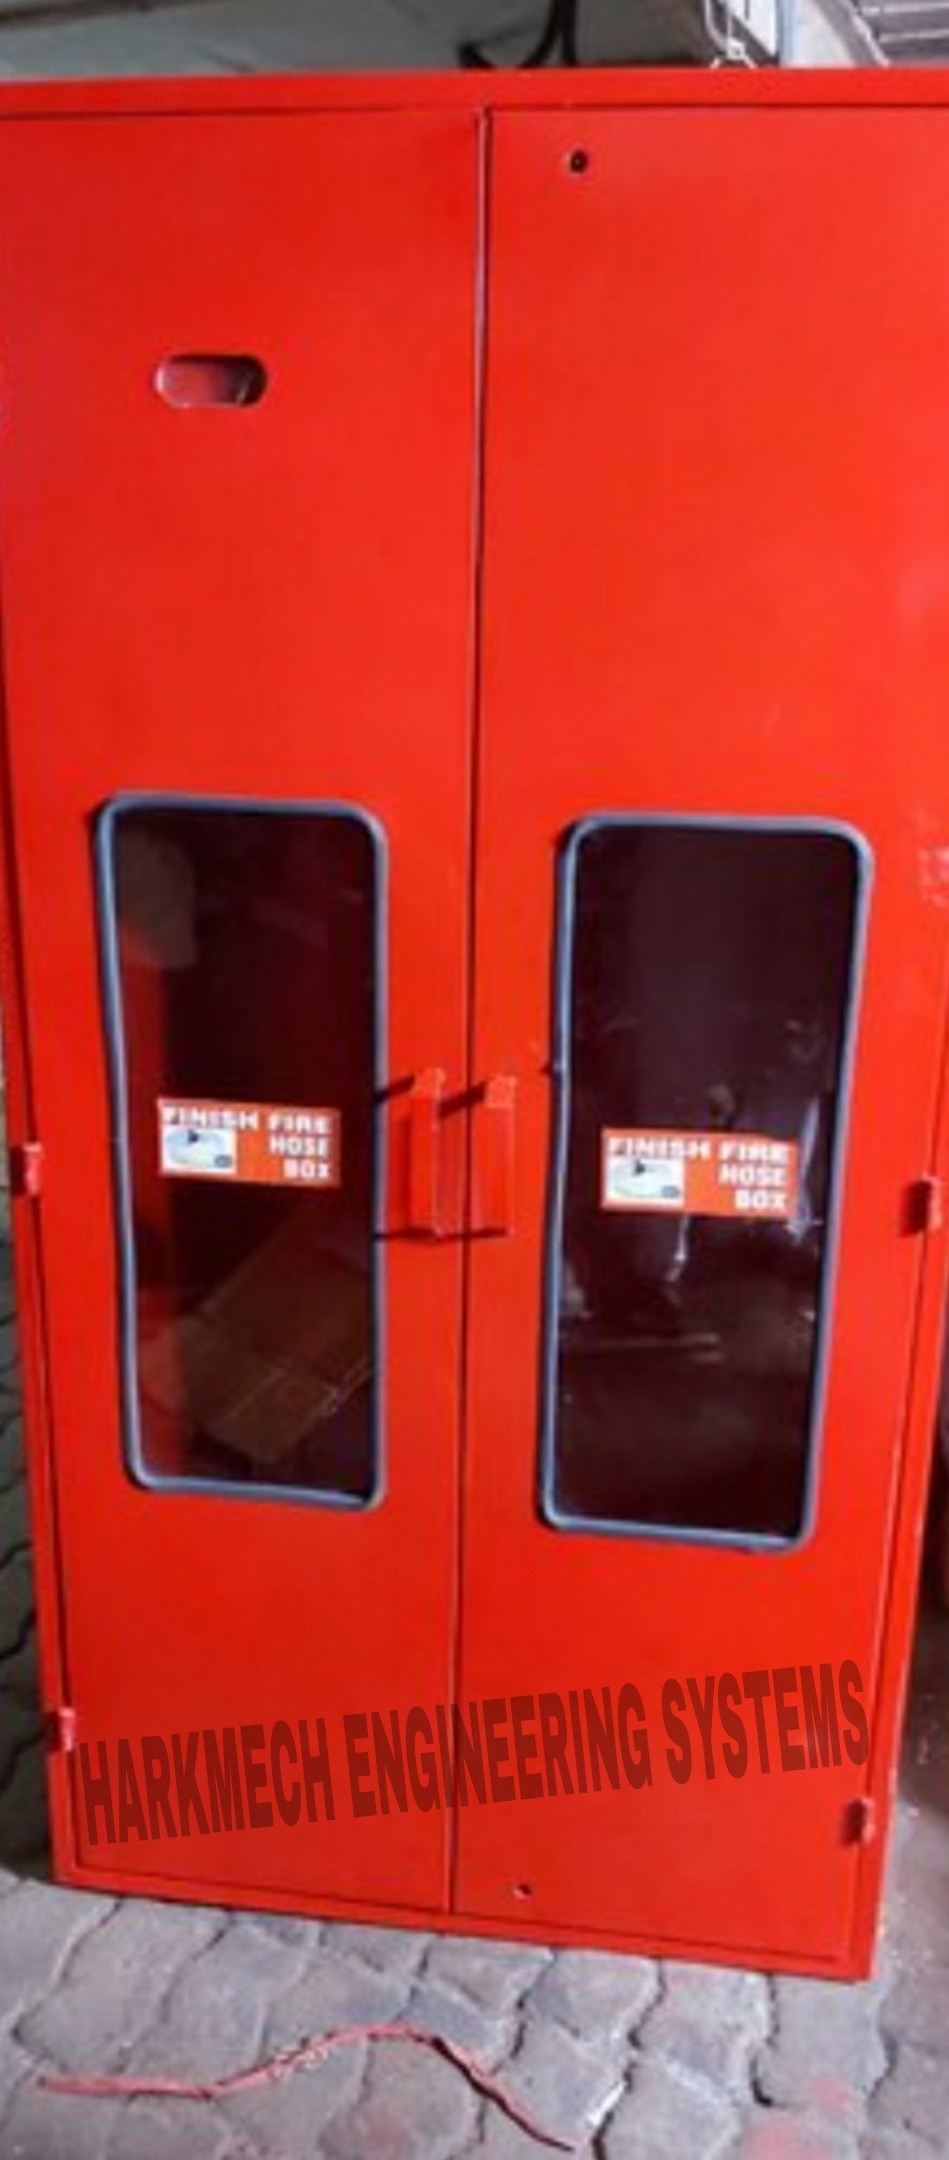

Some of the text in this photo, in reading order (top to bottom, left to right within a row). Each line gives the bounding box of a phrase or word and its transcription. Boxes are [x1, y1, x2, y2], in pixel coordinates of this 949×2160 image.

[163, 1106, 331, 1133] FINISH FIRE
[269, 1135, 330, 1156] HOSE
[608, 1137, 789, 1162] FINISH FIRE
[283, 1157, 329, 1180] BOX
[718, 1162, 787, 1186] HOSE
[734, 1188, 787, 1209] BOX
